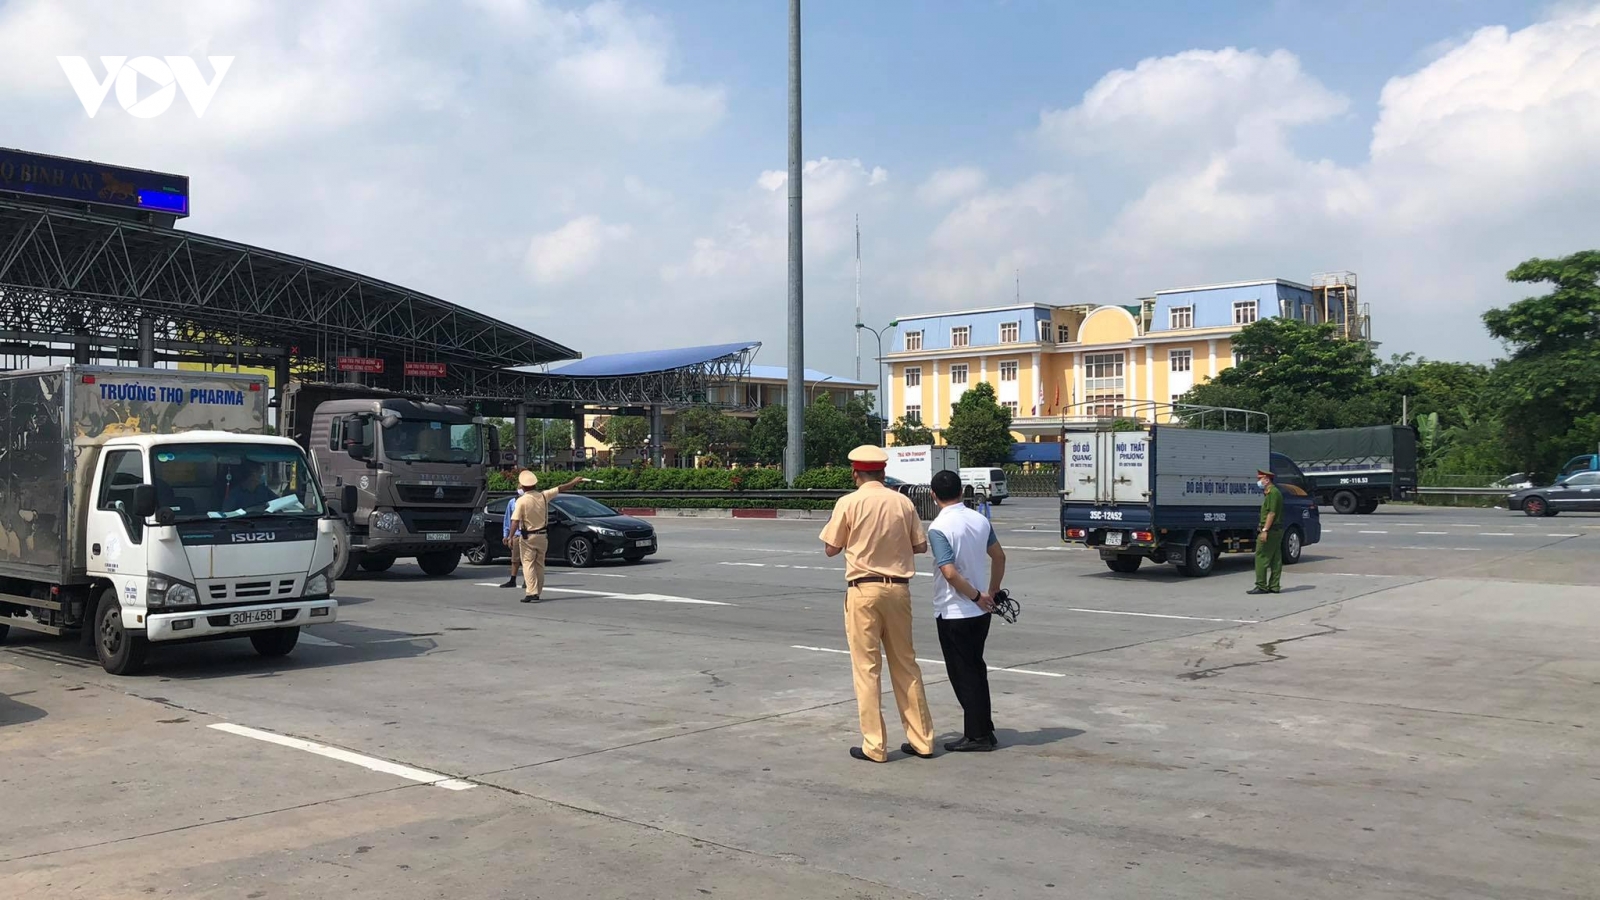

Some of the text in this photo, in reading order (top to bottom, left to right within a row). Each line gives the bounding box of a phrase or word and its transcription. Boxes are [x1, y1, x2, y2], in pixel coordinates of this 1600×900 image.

[100, 382, 244, 406] TRƯỜNG THỌ PHARMA
[1116, 442, 1126, 453] NỘI
[1130, 441, 1145, 452] THẤT
[1215, 478, 1228, 494] THẤT
[1229, 482, 1246, 495] QUANG
[1090, 511, 1122, 521] 35C-12452
[231, 532, 276, 542] ISUZU
[232, 610, 277, 624] 30H-4581
